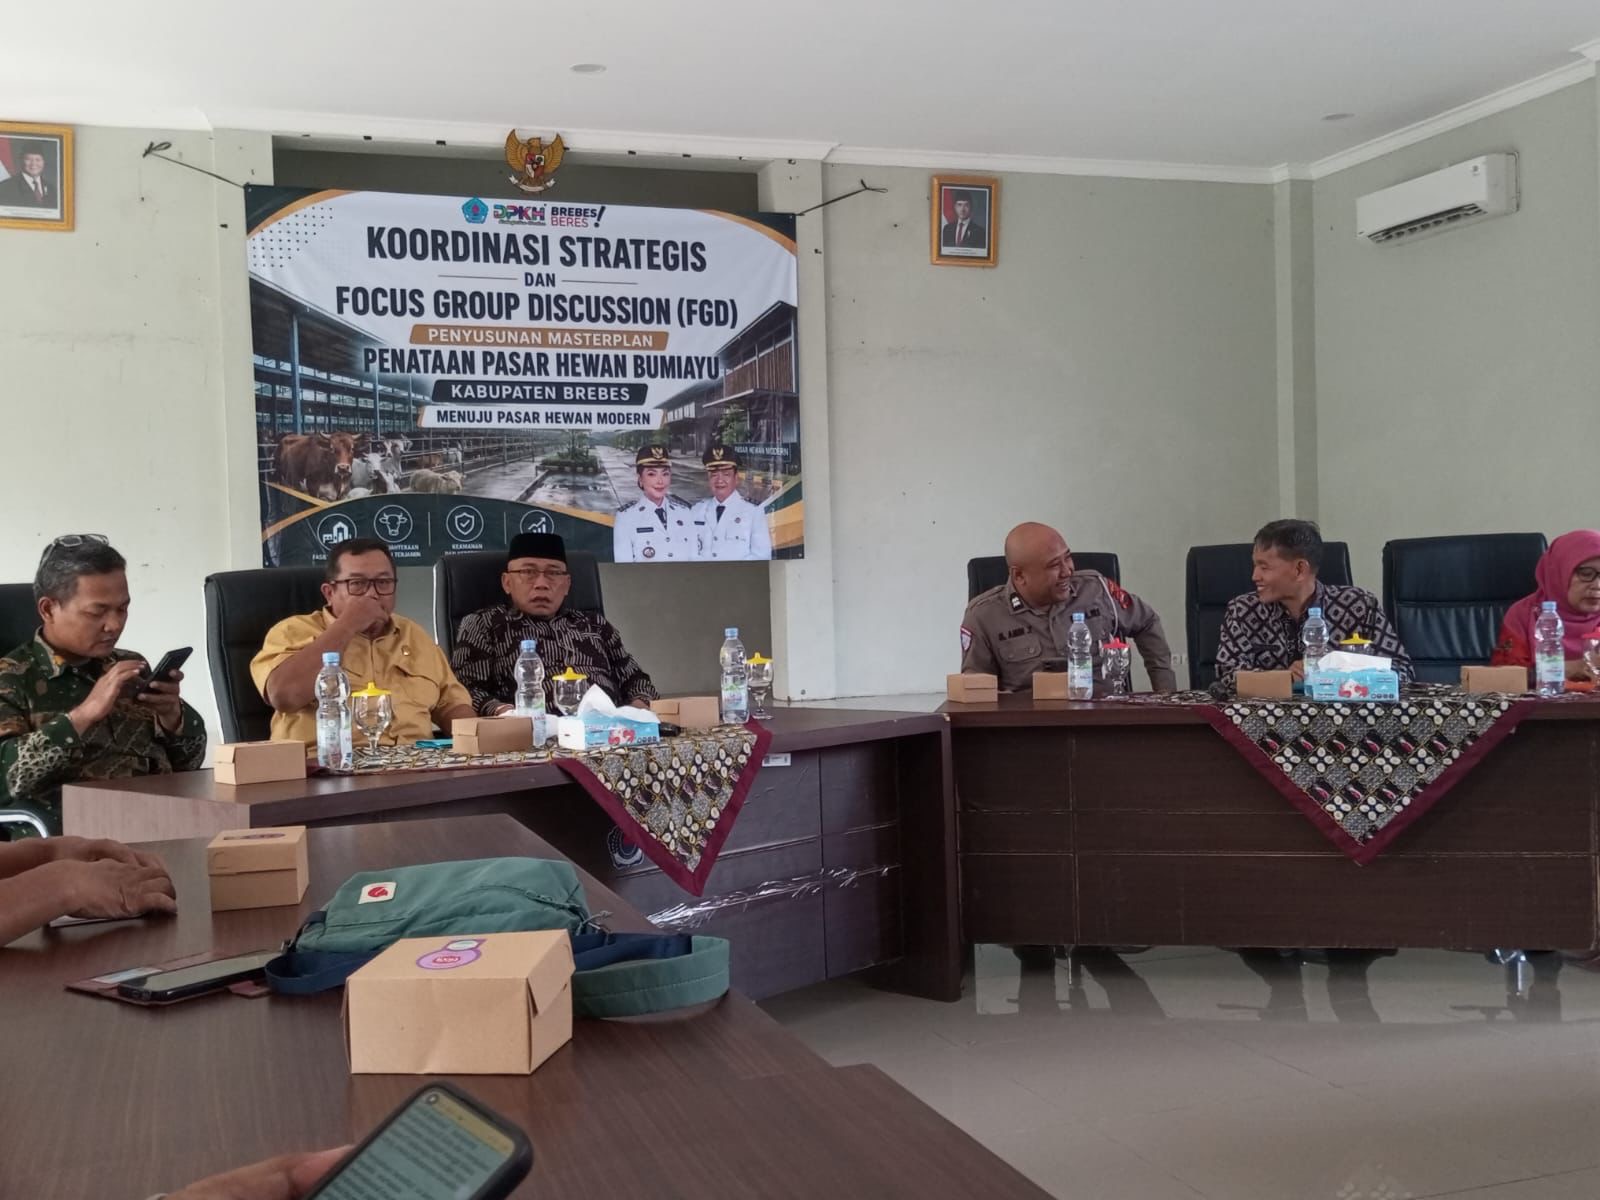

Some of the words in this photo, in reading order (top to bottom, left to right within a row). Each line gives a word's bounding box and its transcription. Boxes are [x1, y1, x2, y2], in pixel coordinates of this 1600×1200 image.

[493, 204, 546, 221] DPKH
[551, 217, 589, 228] BERES
[367, 226, 550, 266] KOORDINASI
[559, 235, 707, 272] STRATEGIS
[524, 272, 556, 288] DAN
[336, 286, 425, 318] FOCUS
[433, 290, 520, 322] GROUP
[528, 293, 671, 326] DISCUSSION
[677, 297, 738, 330] (FGD)
[427, 328, 543, 346] PENYUSUNAN
[547, 331, 654, 348] MASTERPLAN
[364, 347, 477, 376] PENATAAN
[482, 352, 551, 378] PASAR
[555, 353, 628, 380] HEWAN
[633, 356, 721, 381] BUMIAYU
[450, 384, 556, 401] KABUPATEN
[562, 386, 631, 402] BREBES
[436, 410, 493, 425] MENUJU
[496, 411, 542, 426] PASAR
[544, 412, 592, 426] HEWAN
[595, 413, 651, 426] MODERN
